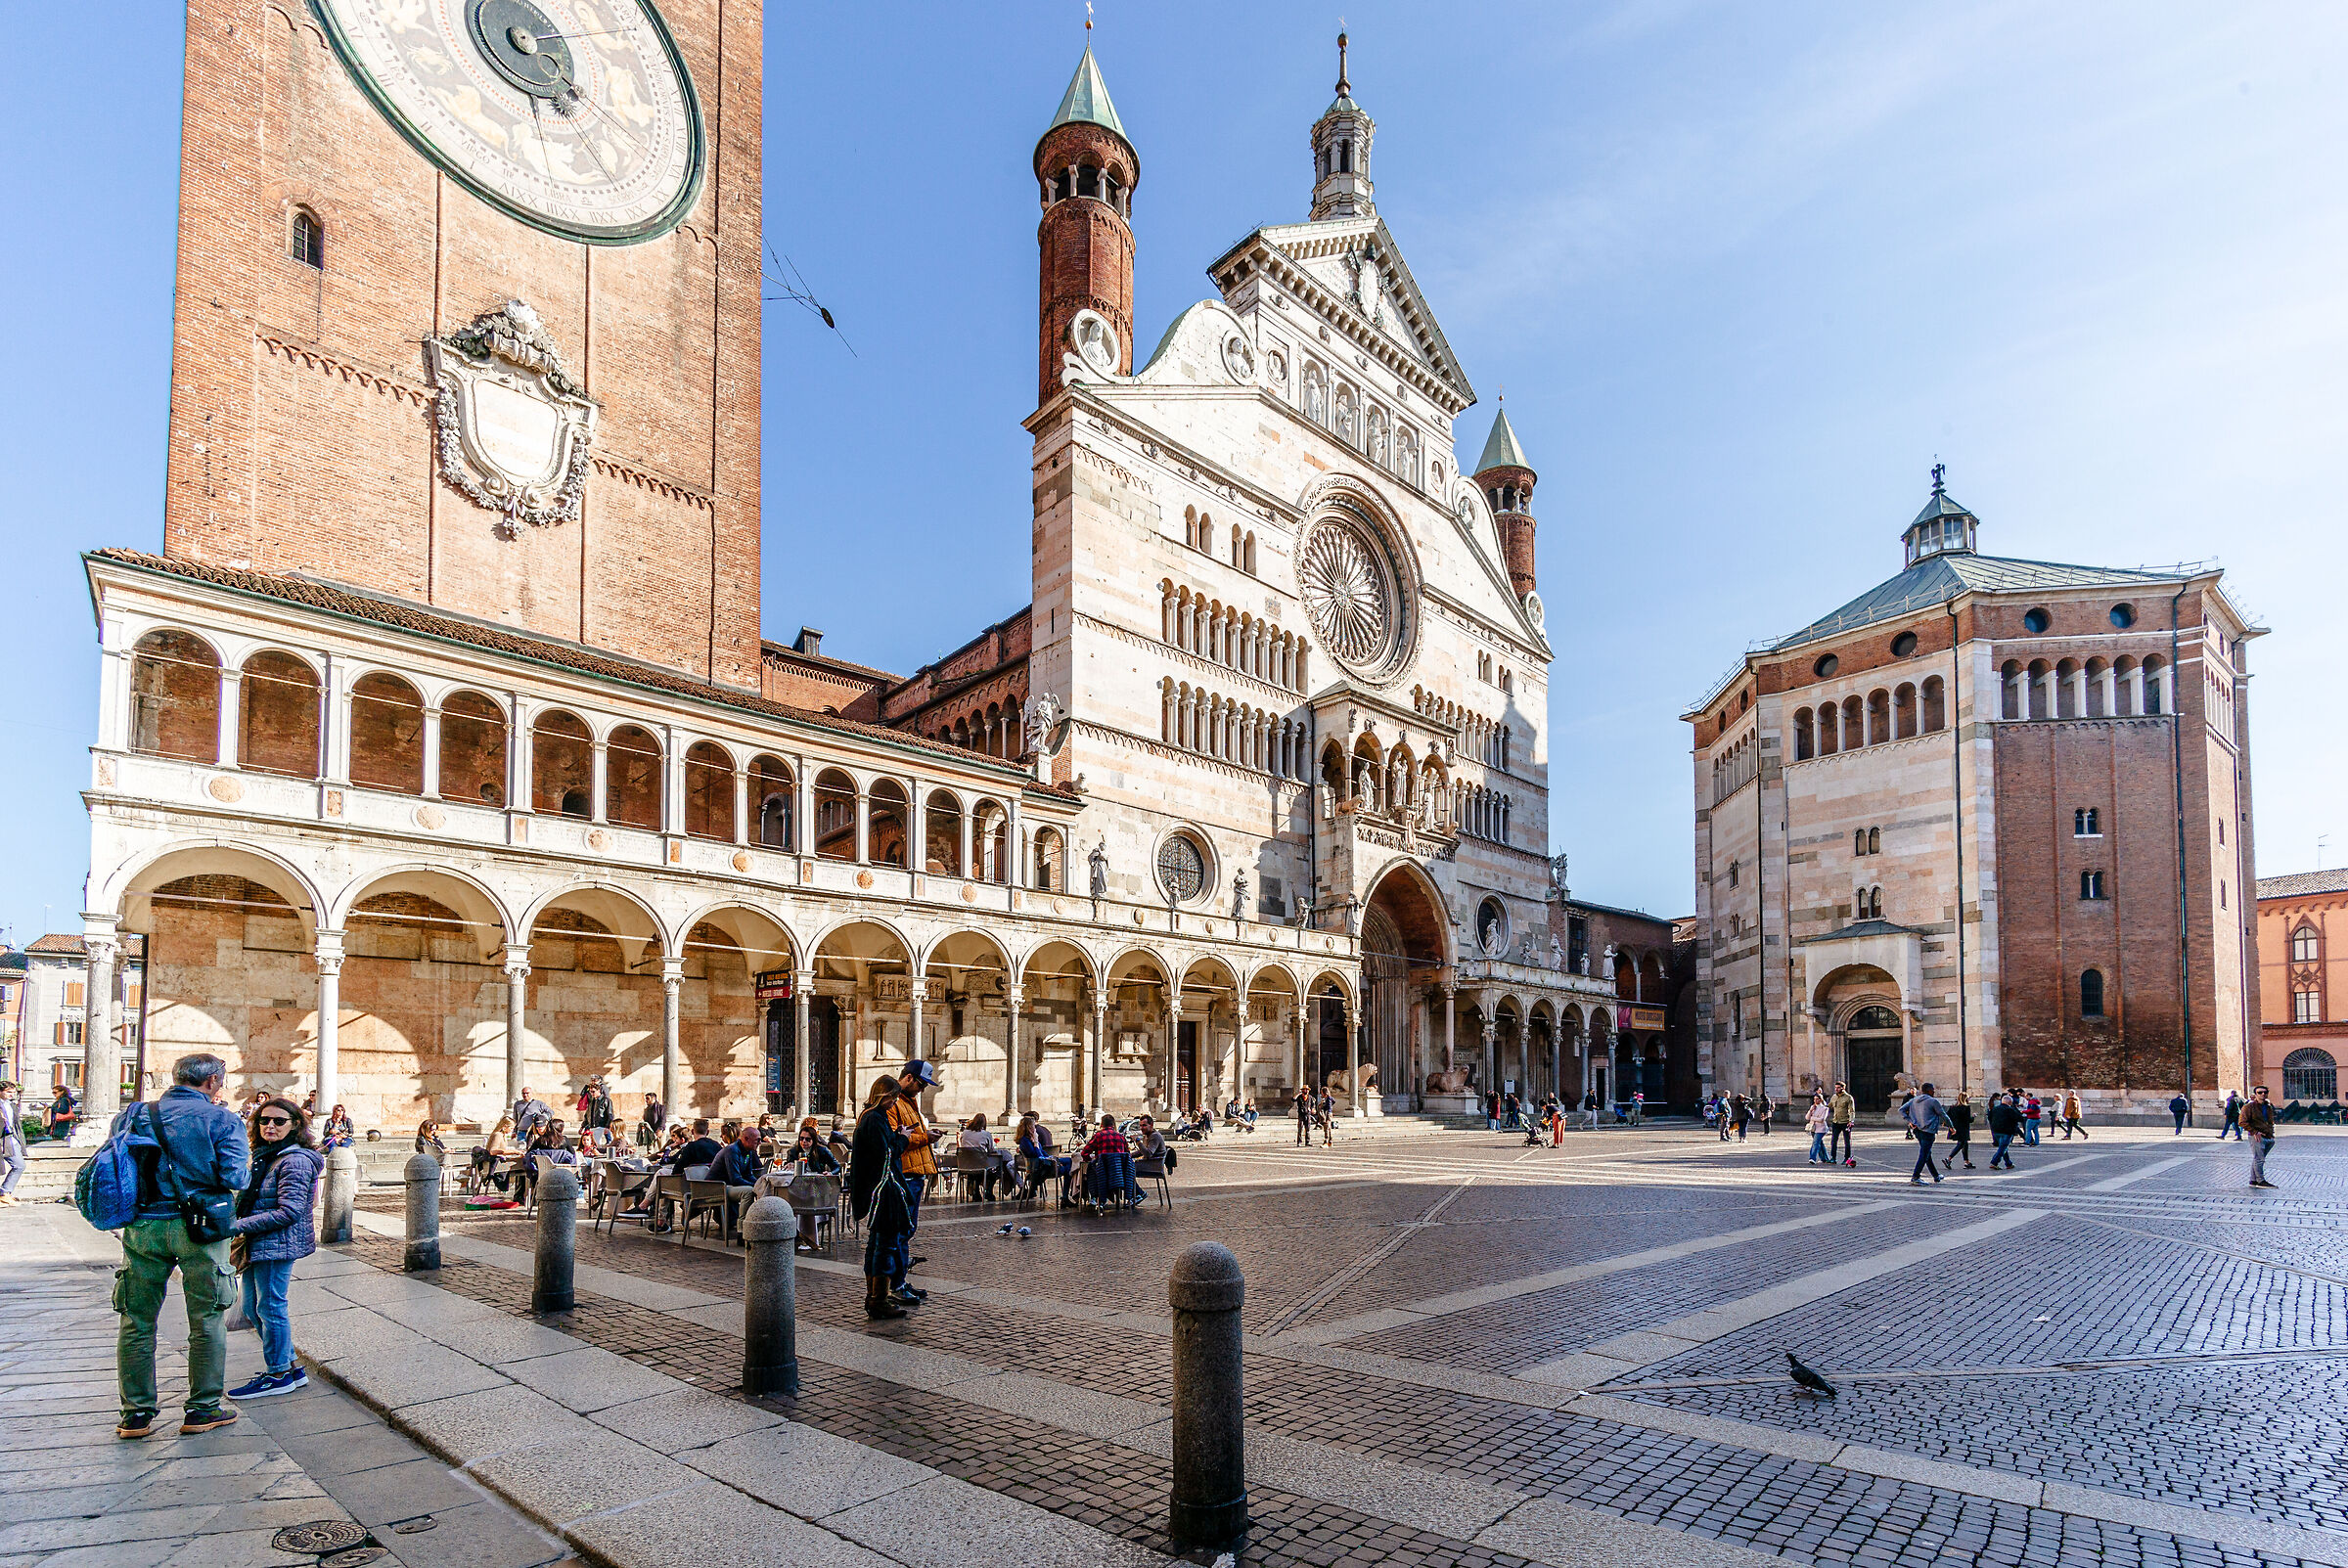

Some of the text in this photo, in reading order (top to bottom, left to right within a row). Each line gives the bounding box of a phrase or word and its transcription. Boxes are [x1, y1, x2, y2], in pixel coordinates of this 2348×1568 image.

[377, 72, 394, 88] III
[671, 90, 684, 117] XVII
[420, 120, 433, 133] II
[675, 127, 687, 156] XVIII
[460, 139, 490, 164] VIRGO
[668, 163, 684, 180] XIX
[498, 182, 539, 209] XXIV
[544, 187, 572, 203] LIBRA
[652, 188, 670, 205] XX
[546, 202, 581, 221] XXIII
[589, 210, 618, 224] XXII
[625, 203, 648, 221] XXI
